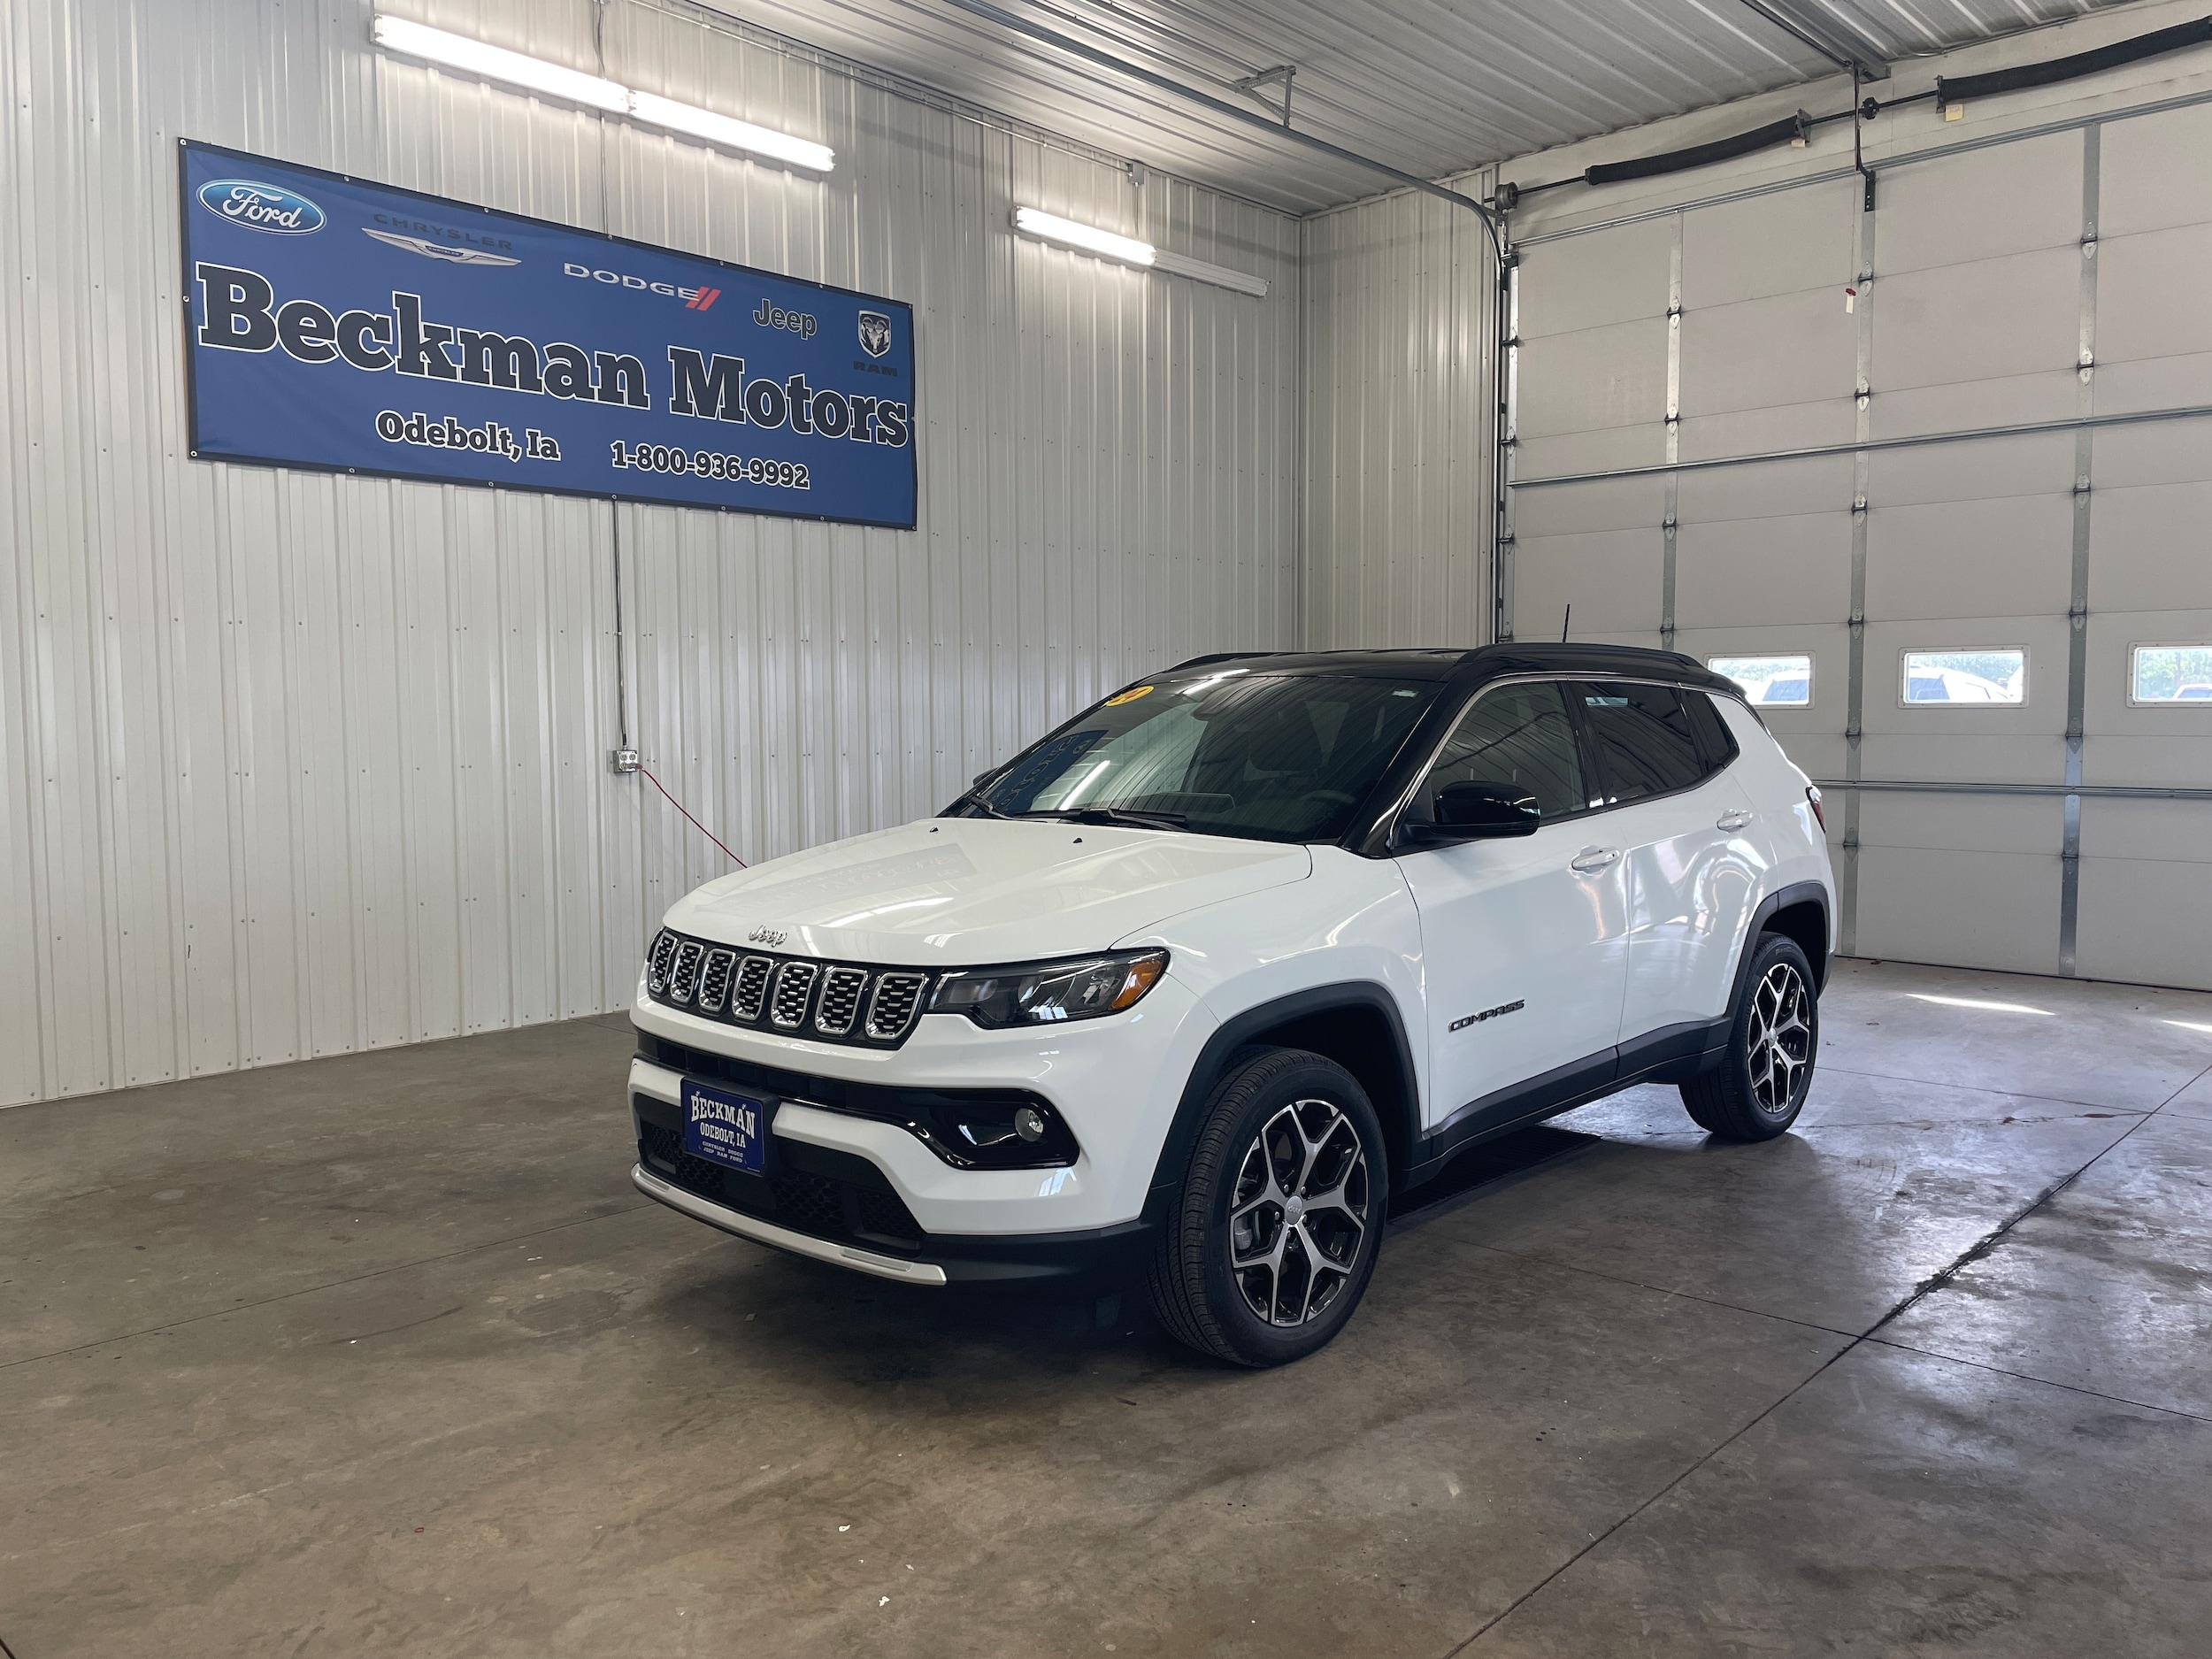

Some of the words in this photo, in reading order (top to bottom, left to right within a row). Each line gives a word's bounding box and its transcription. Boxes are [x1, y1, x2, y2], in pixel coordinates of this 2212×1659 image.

[222, 187, 303, 230] Ford
[373, 212, 513, 250] CHRYSLER
[564, 262, 700, 302] DODGE
[753, 298, 817, 340] Jeep
[196, 260, 650, 411] Beckman
[667, 344, 909, 448] Motors
[853, 360, 898, 377] RAM
[375, 409, 522, 462] Odebolt,
[526, 428, 561, 461] Ia
[610, 440, 810, 490] 1-800-936-9992
[749, 925, 787, 948] Jeep
[1448, 999, 1525, 1033] COMPASS
[690, 1094, 756, 1140] BECKMAN
[700, 1121, 735, 1148] ODEBOLT,
[736, 1133, 746, 1148] IA
